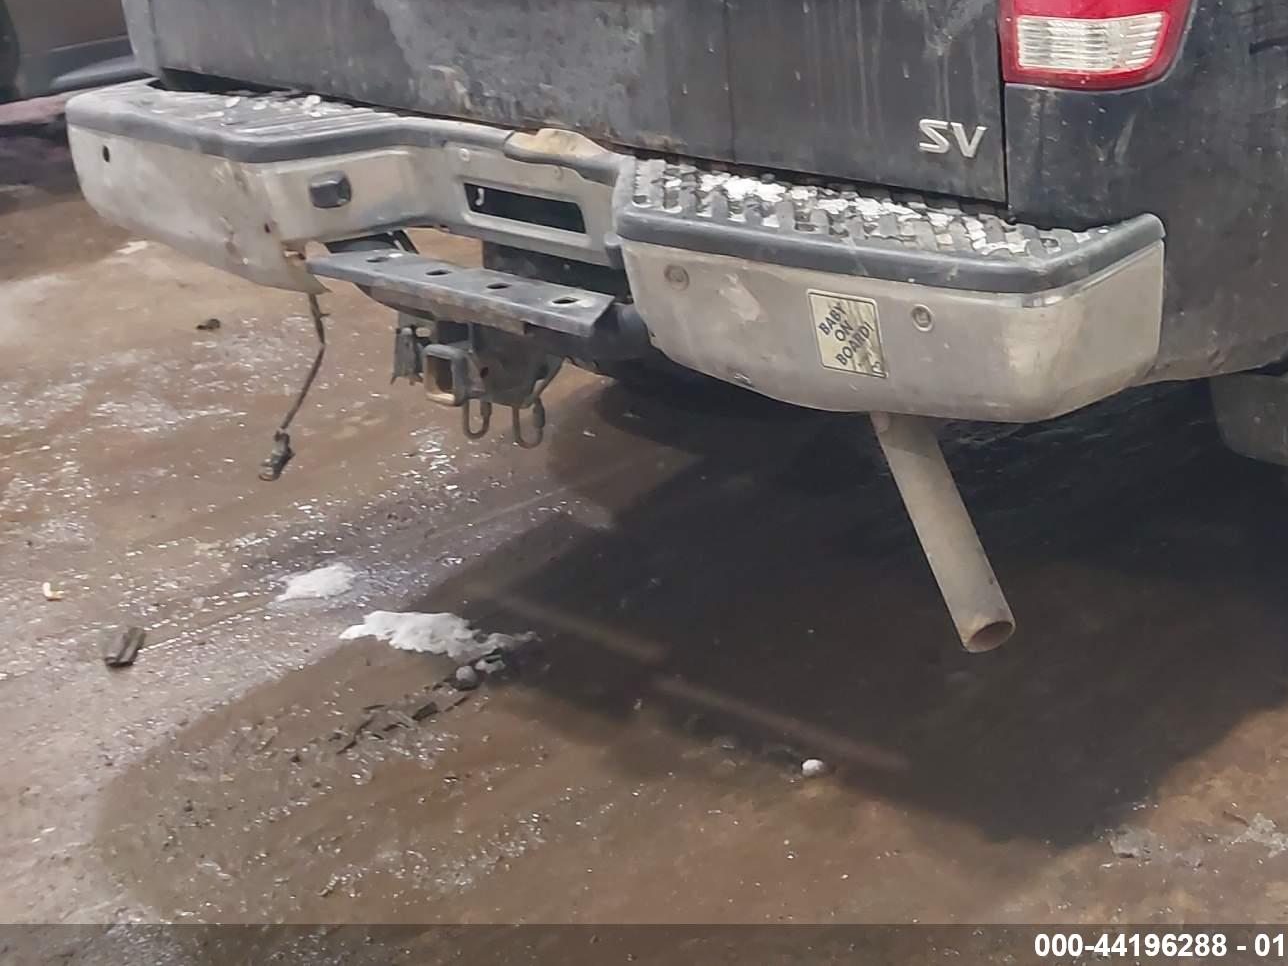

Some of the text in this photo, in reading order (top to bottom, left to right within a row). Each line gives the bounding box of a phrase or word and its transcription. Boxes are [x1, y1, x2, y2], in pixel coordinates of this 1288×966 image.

[919, 119, 988, 158] SV
[819, 302, 847, 336] BABY
[835, 320, 854, 342] ON
